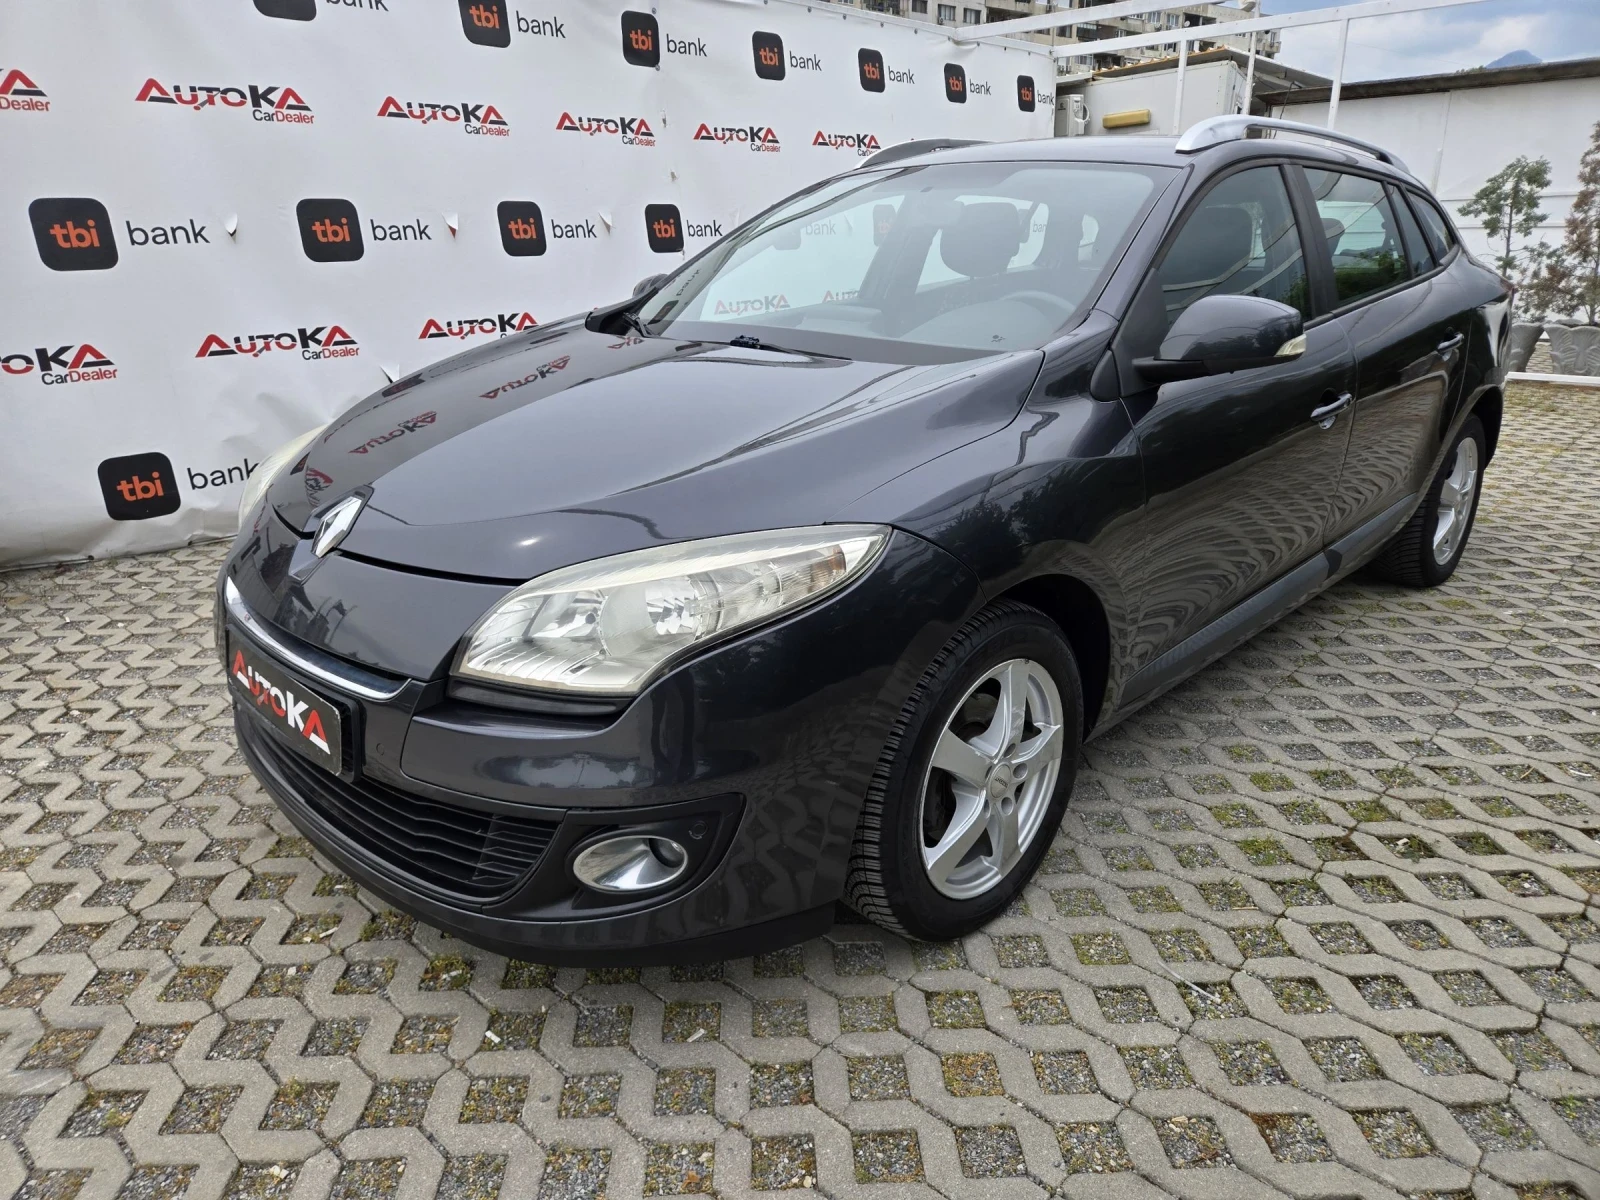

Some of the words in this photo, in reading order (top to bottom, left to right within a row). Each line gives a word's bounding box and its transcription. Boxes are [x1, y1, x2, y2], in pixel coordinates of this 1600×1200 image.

[469, 4, 501, 29] tbi
[516, 11, 566, 39] bank
[629, 29, 653, 51] tbi
[666, 34, 708, 58] bank
[759, 48, 779, 67] tbi
[789, 50, 823, 72] bank
[863, 62, 880, 81] tbi
[888, 66, 915, 85] bank
[948, 76, 963, 93] tbi
[969, 79, 992, 96] bank
[1020, 87, 1032, 102] tbi
[1037, 89, 1055, 106] bank
[252, 109, 315, 125] CarDealer
[464, 124, 511, 137] CarDealer
[621, 135, 656, 147] CarDealer
[750, 143, 781, 153] CarDealer
[49, 219, 101, 248] tbi
[126, 219, 210, 247] bank
[312, 218, 350, 243] tbi
[370, 219, 432, 241] bank
[508, 218, 537, 240] tbi
[551, 219, 597, 239] bank
[653, 219, 676, 239] tbi
[686, 219, 724, 238] bank
[0, 344, 116, 374] OKA
[301, 345, 360, 361] CarDealer
[41, 367, 118, 386] CarDealer
[116, 472, 165, 502] tbi
[187, 458, 259, 490] bank
[232, 650, 331, 755] AUTOKA
